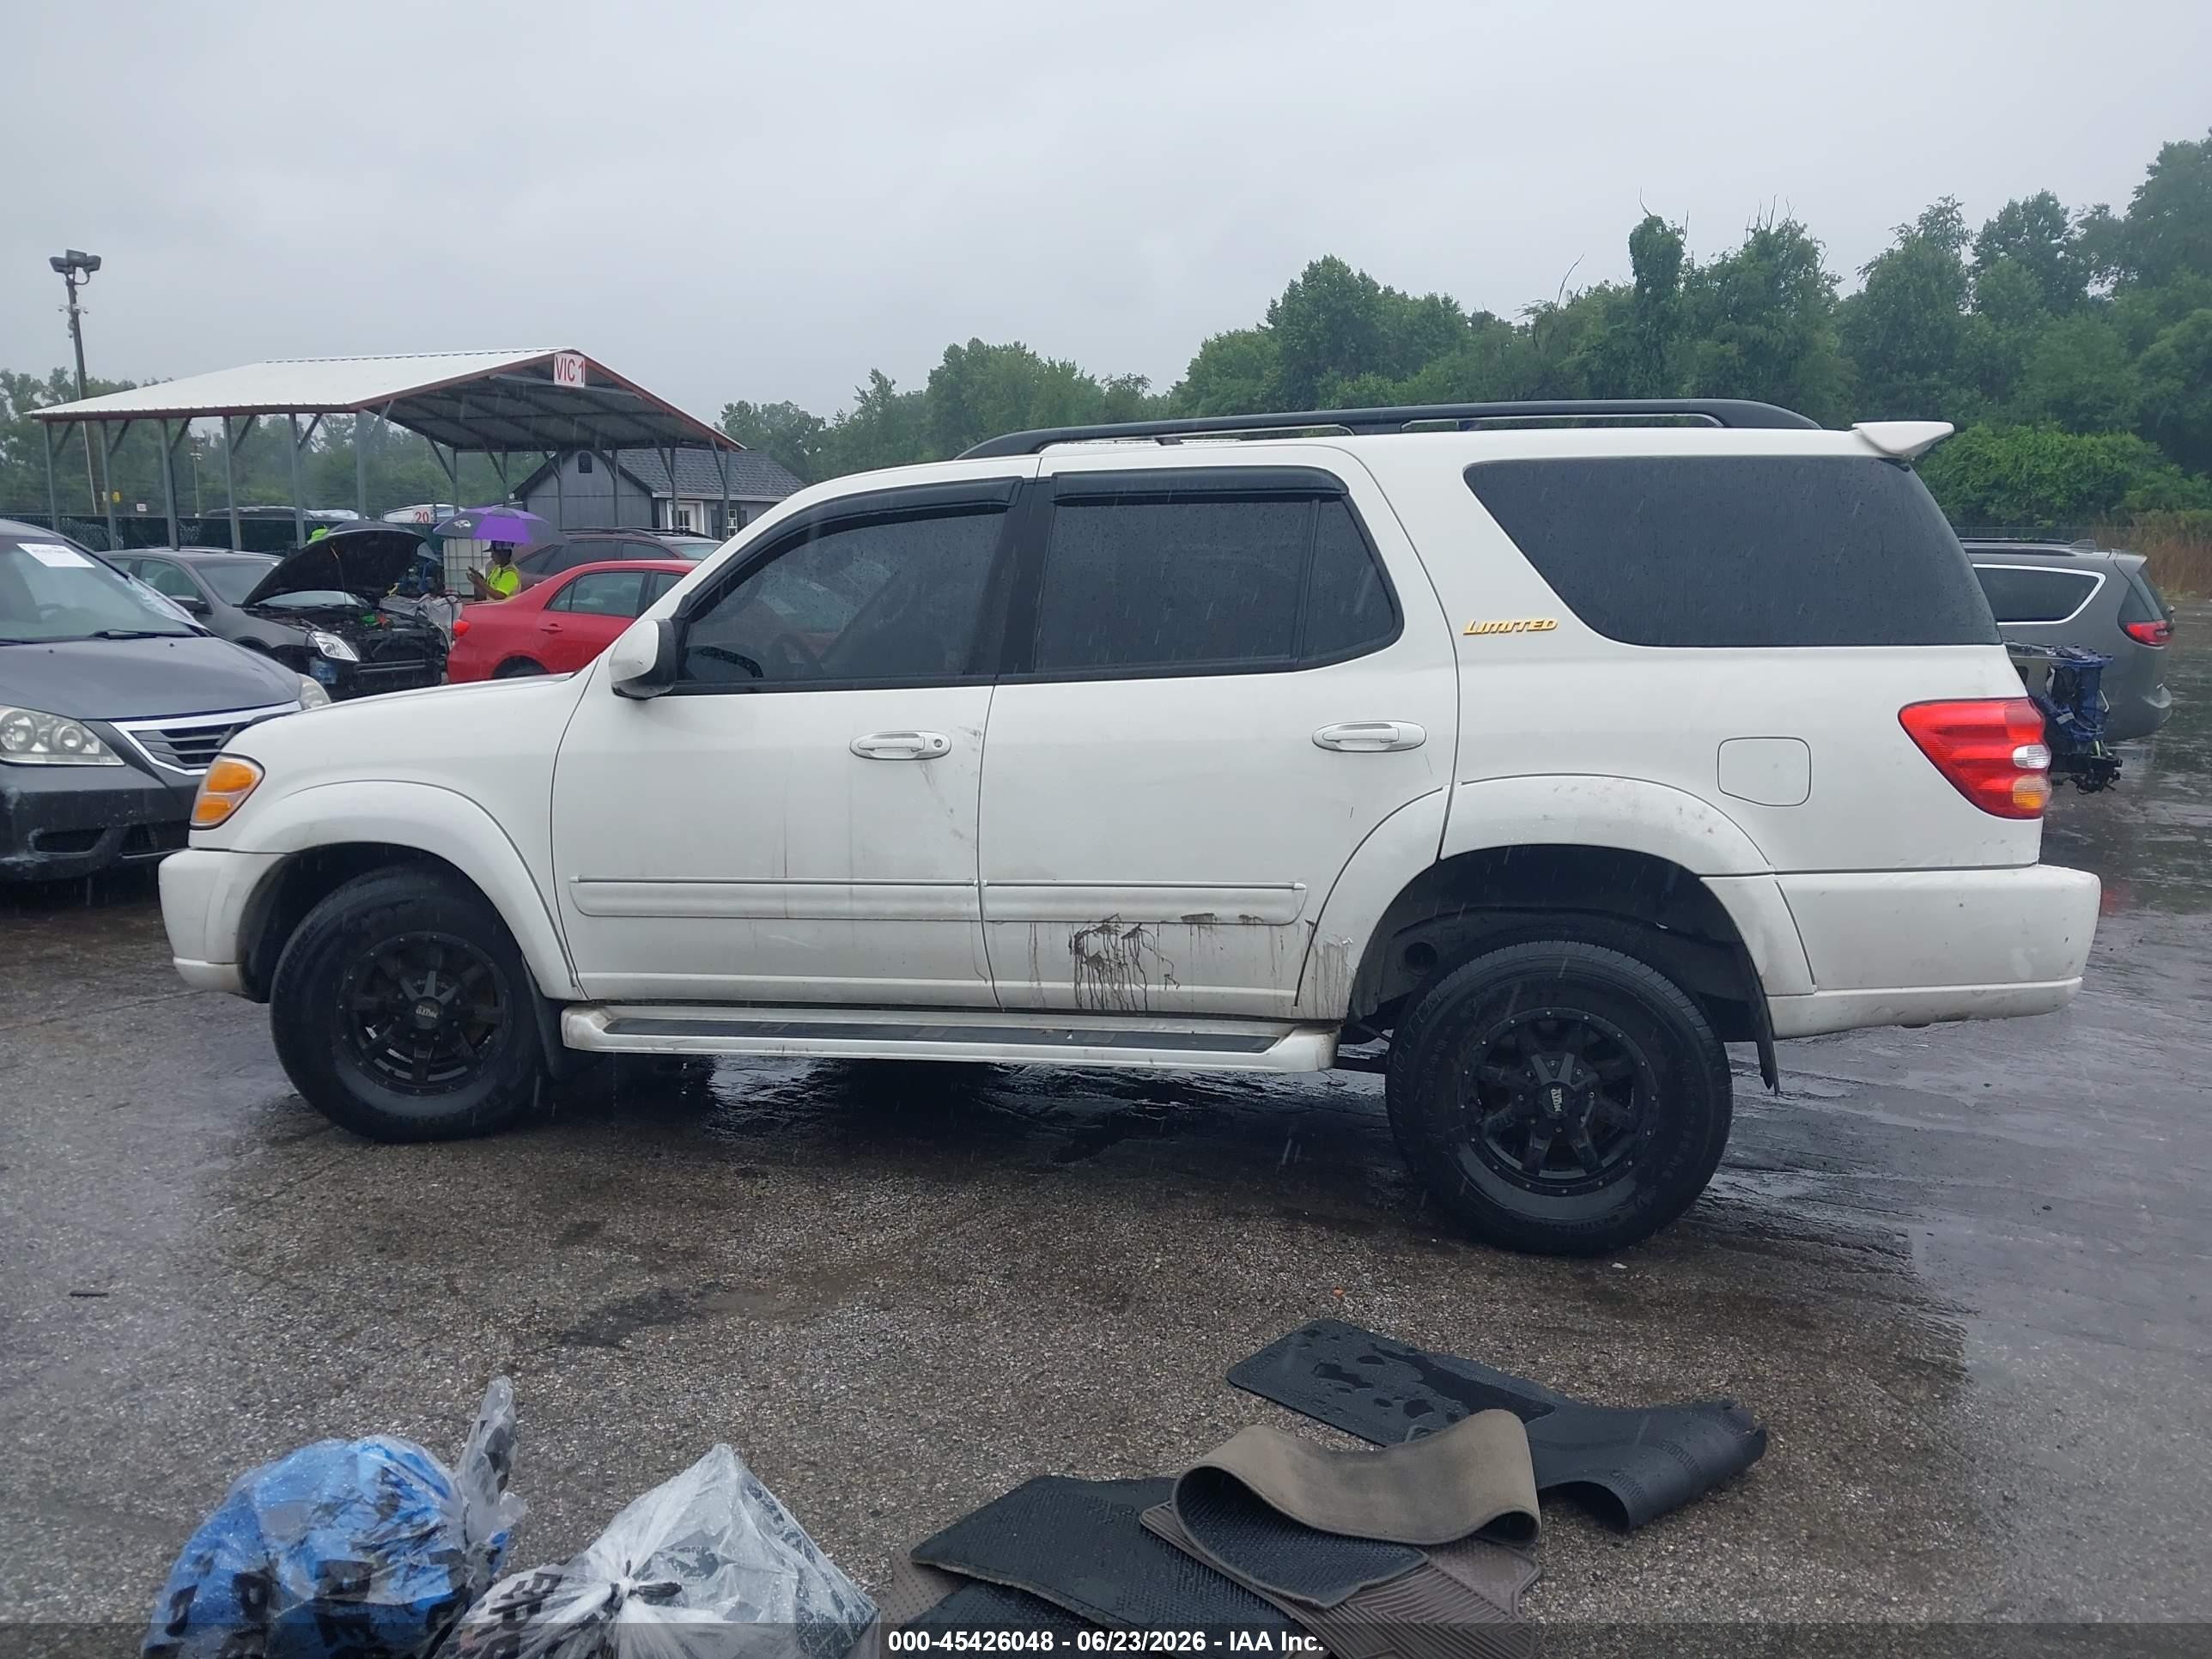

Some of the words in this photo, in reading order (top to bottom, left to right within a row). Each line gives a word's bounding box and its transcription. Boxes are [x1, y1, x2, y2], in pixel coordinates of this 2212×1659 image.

[556, 356, 575, 382] VIC
[578, 361, 584, 383] 1
[415, 512, 429, 523] 20
[1462, 618, 1558, 635] LIMITED
